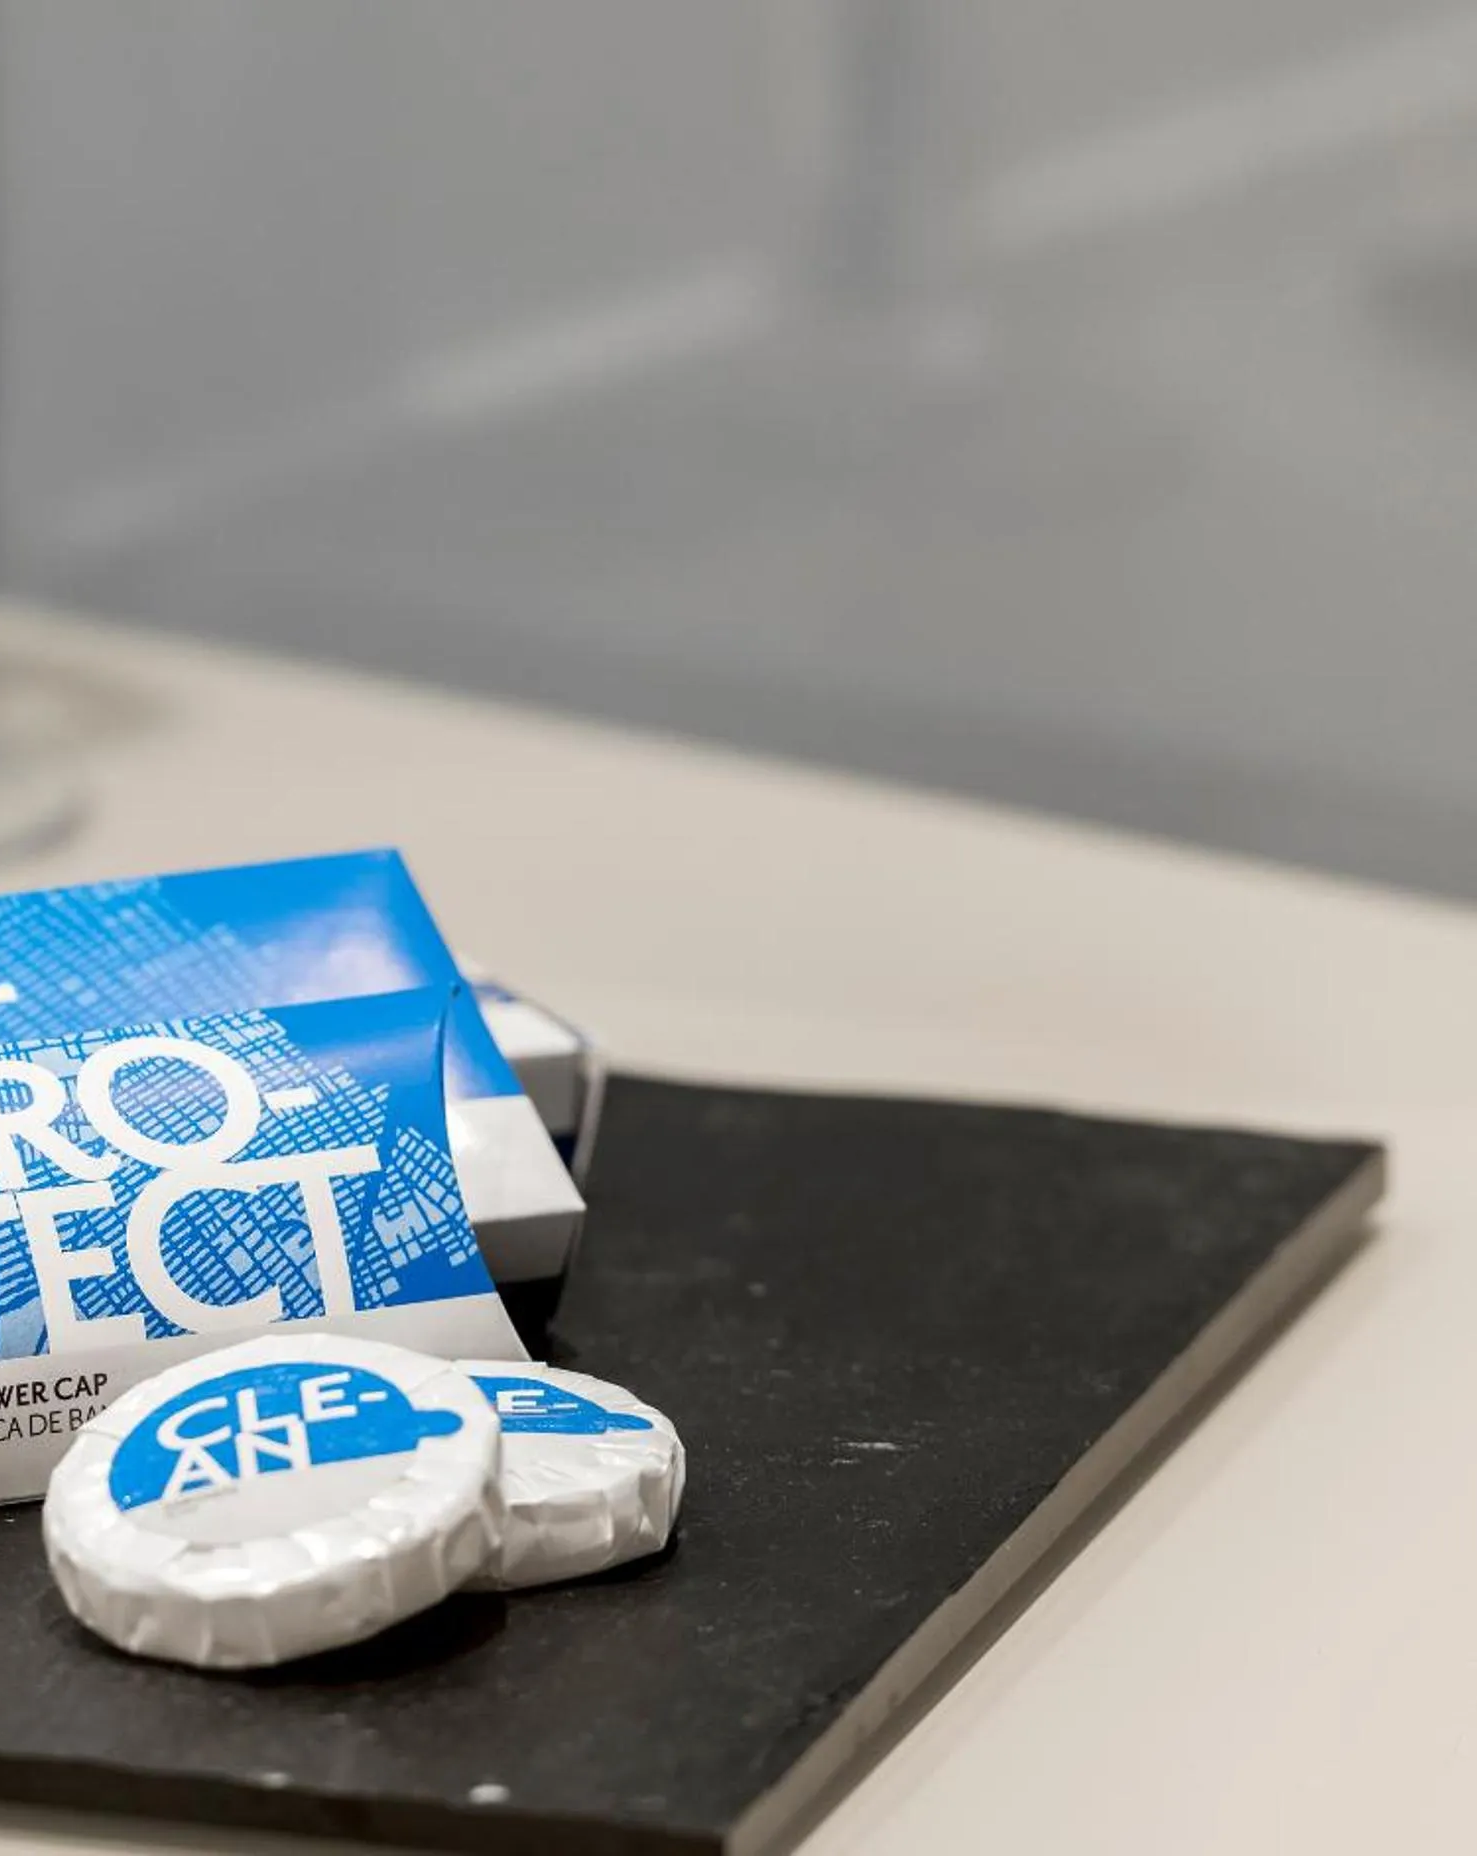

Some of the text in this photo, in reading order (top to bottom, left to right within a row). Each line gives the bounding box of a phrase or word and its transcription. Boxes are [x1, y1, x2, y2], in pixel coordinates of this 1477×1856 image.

[54, 1373, 108, 1400] CAP
[156, 1372, 387, 1450] CLE-
[29, 1411, 62, 1438] DE
[69, 1403, 107, 1432] BA
[161, 1414, 312, 1501] AN
